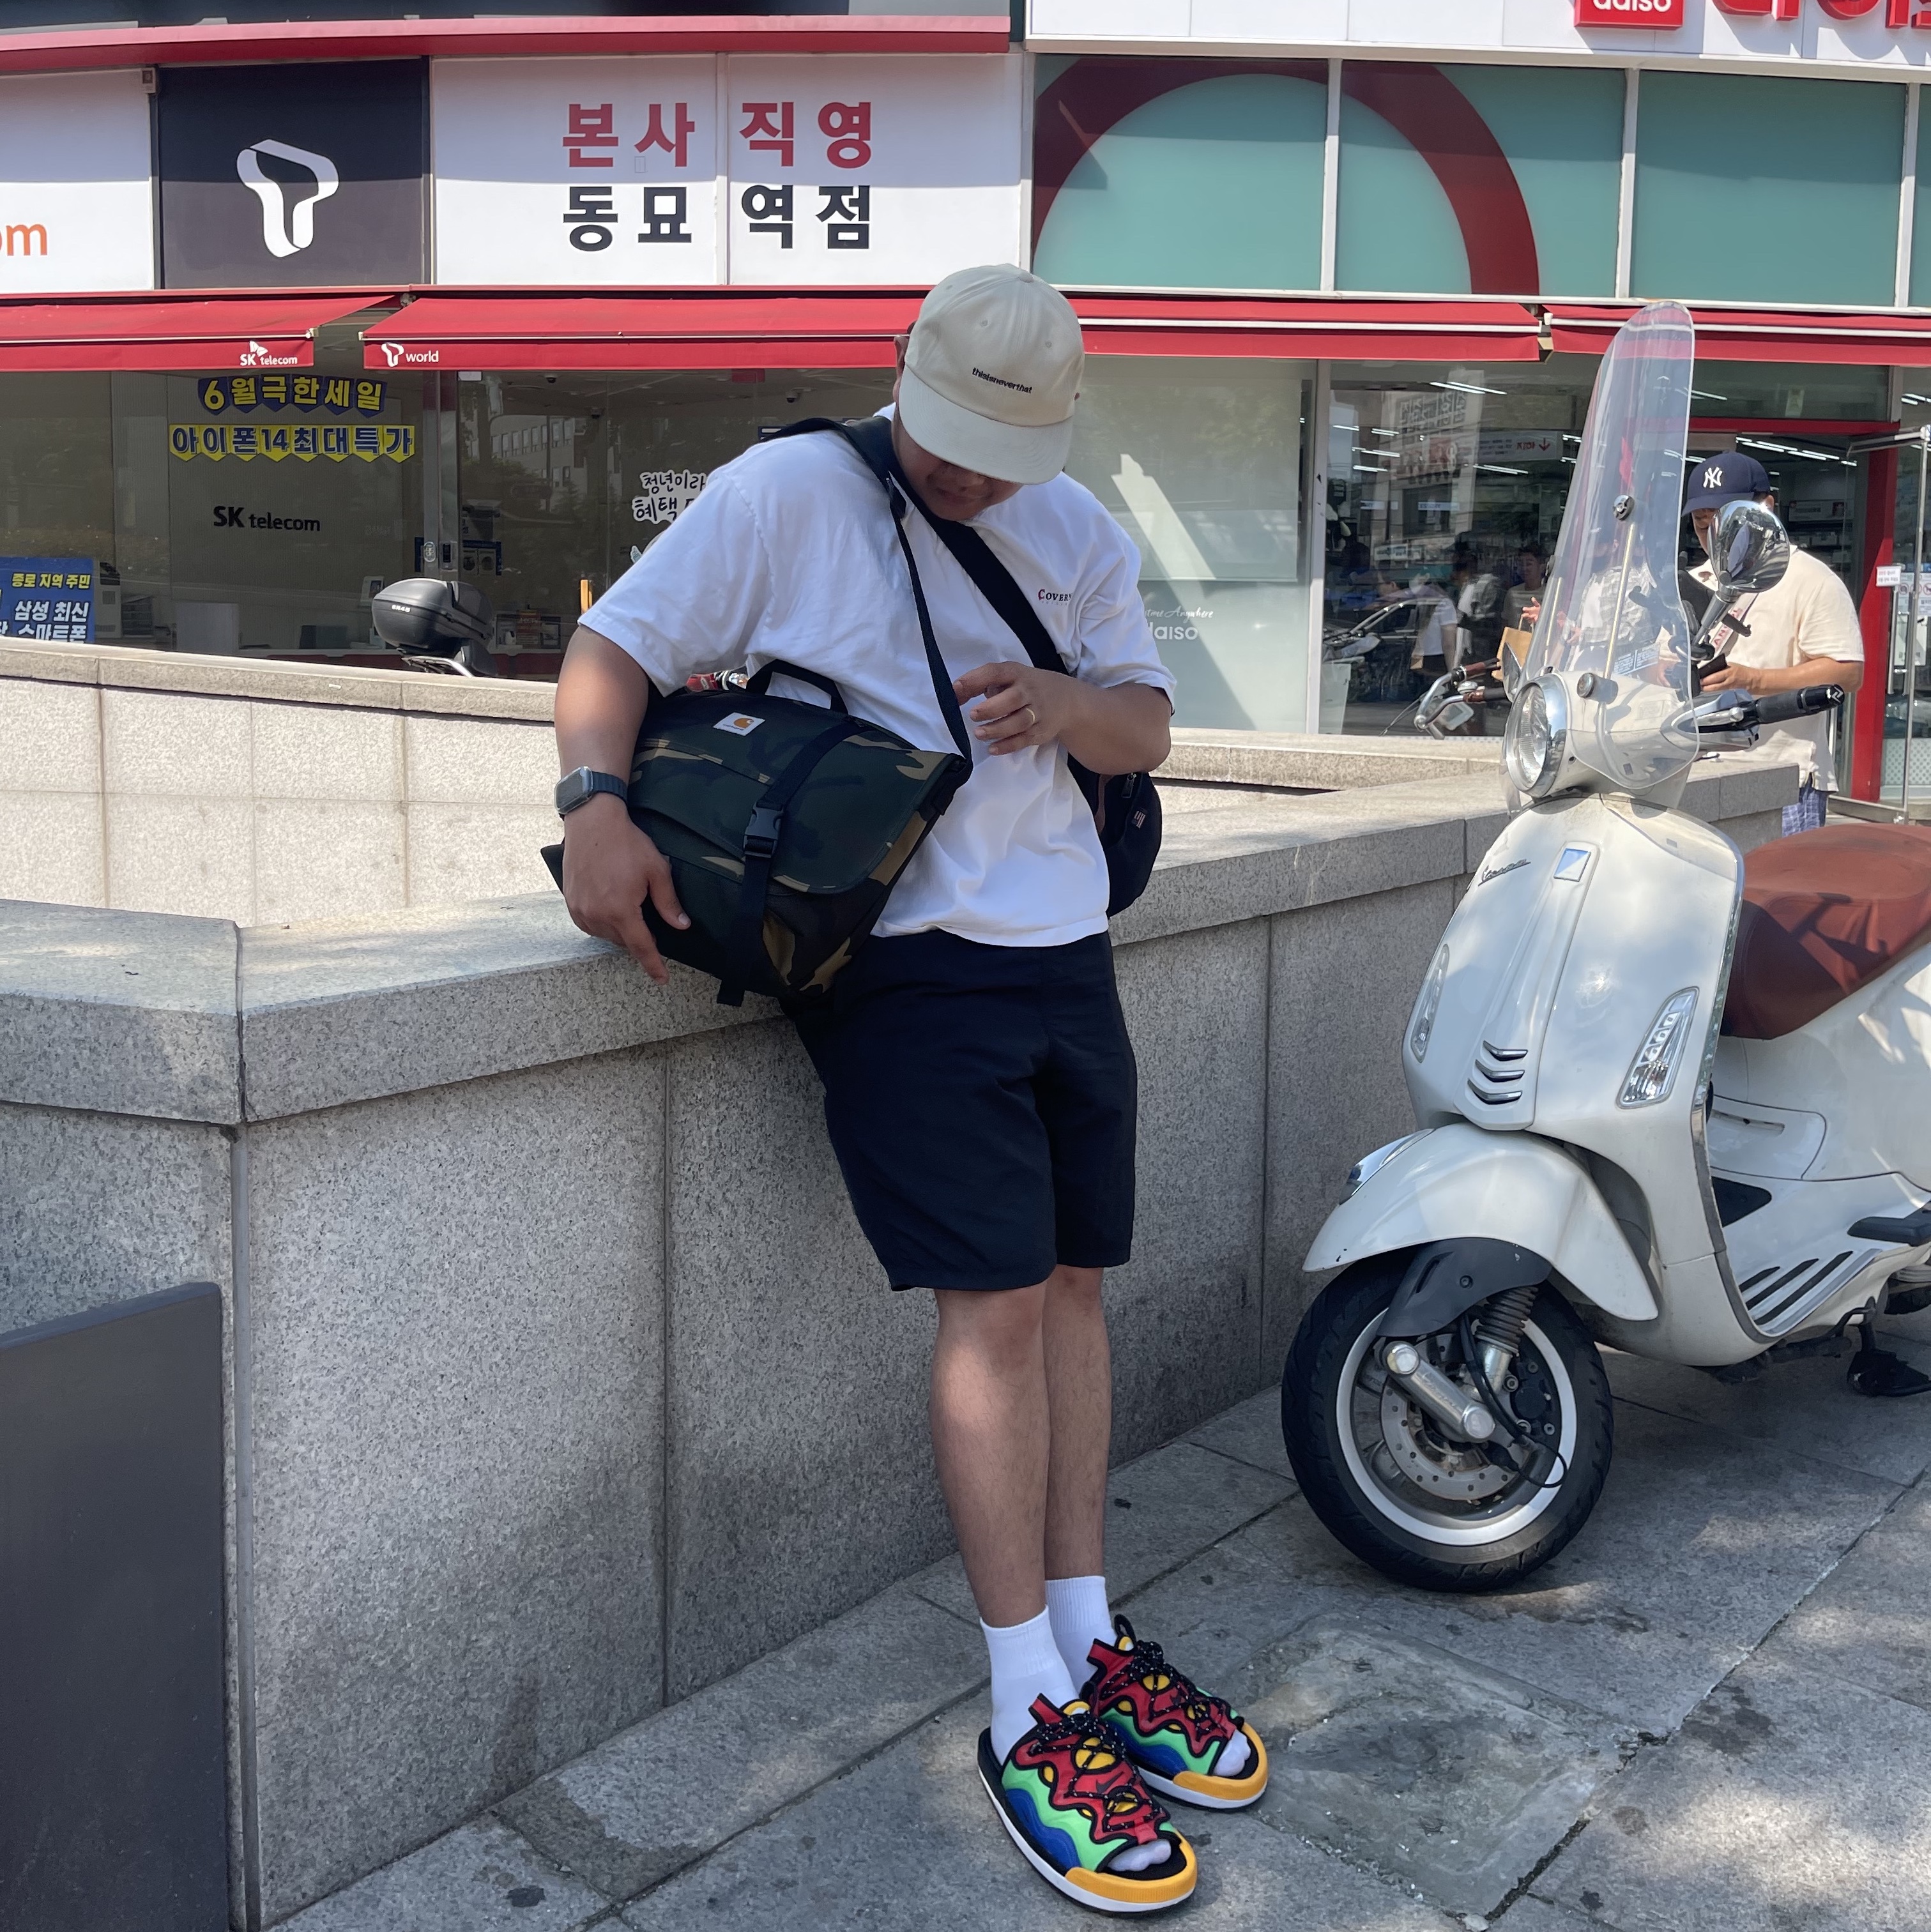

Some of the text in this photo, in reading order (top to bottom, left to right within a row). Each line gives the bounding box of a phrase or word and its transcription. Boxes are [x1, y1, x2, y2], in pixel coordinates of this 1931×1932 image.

[563, 102, 871, 169] 본사 직영
[0, 224, 47, 256] m
[240, 354, 298, 366] SK telecom
[406, 350, 439, 363] world
[972, 367, 1032, 393] thisisneverthat
[1703, 467, 1723, 488] NY
[213, 506, 320, 531] SK telecom
[12, 573, 91, 589] 종로 지역 주민
[14, 600, 89, 623] 삼성 최신
